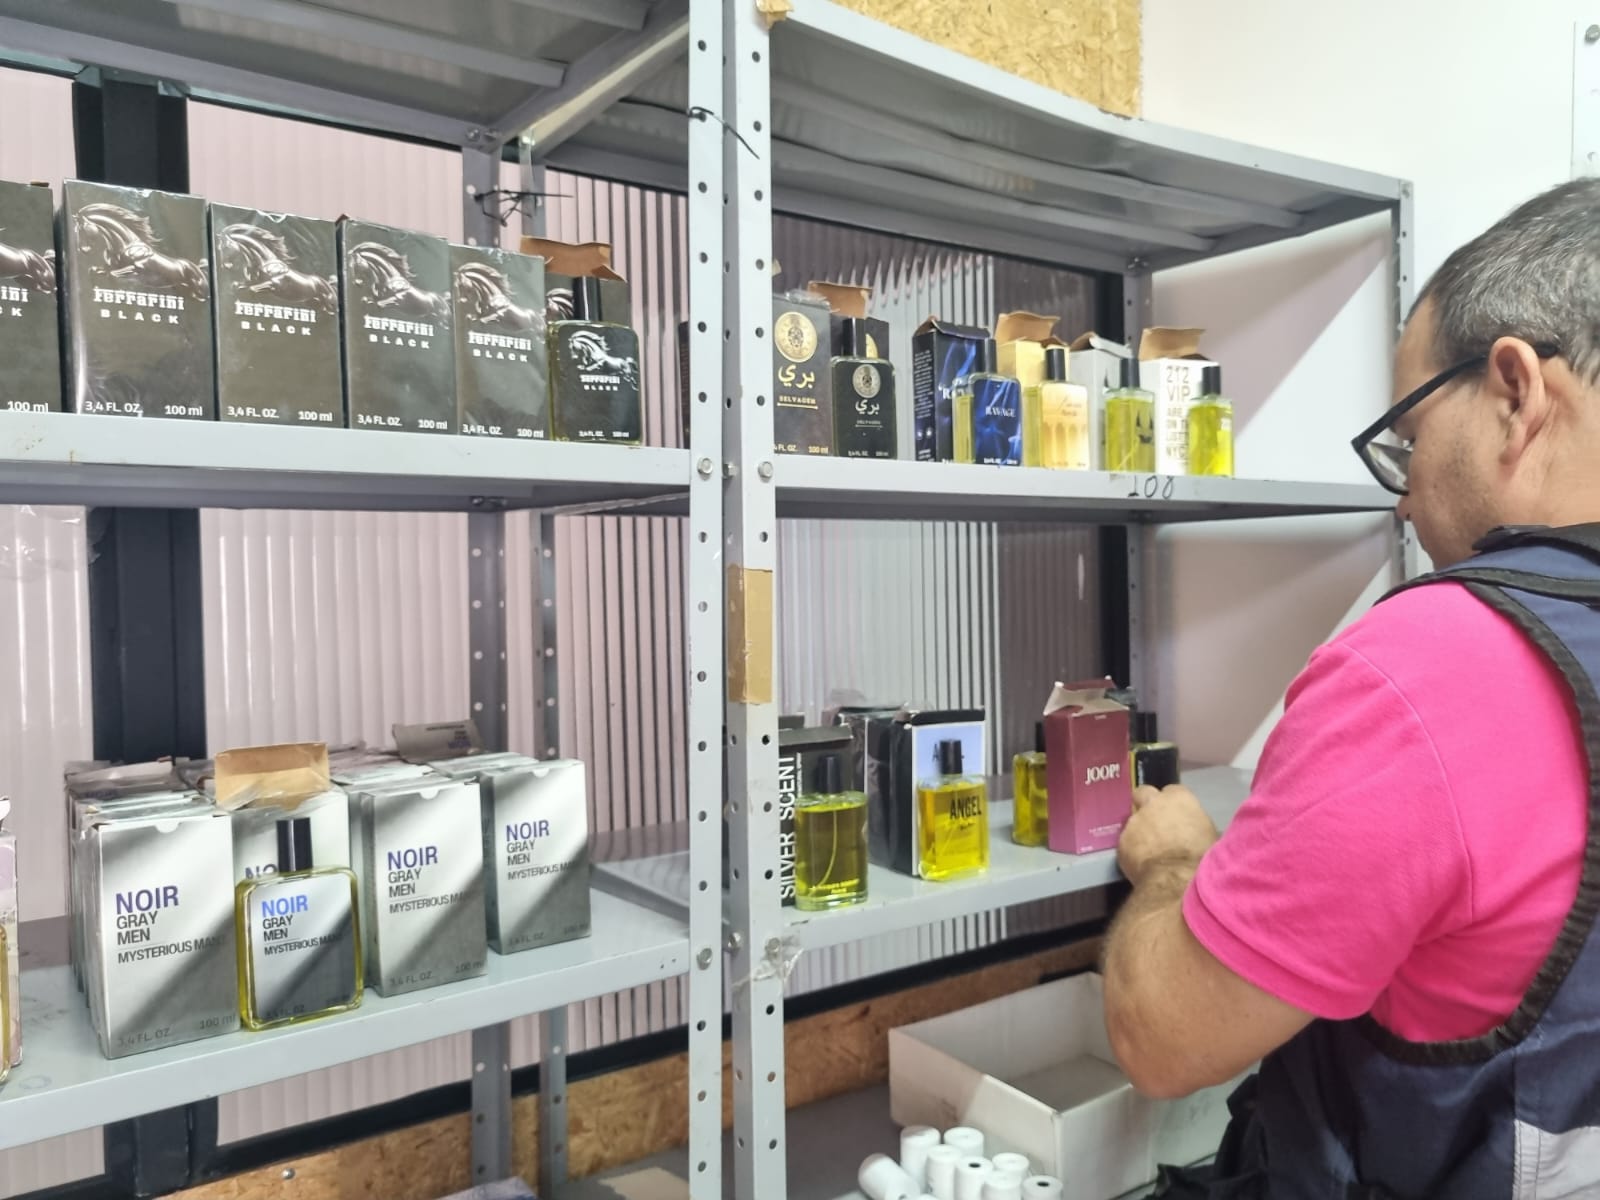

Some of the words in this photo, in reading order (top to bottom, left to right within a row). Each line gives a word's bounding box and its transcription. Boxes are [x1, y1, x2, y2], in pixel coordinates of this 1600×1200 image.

[100, 309, 179, 324] BLACK
[241, 321, 312, 336] BLACK
[369, 334, 430, 349] BLACK
[473, 348, 528, 362] BLACK
[8, 401, 31, 412] 100
[33, 402, 48, 413] ml
[85, 400, 104, 412] 3,4
[164, 404, 186, 416] 100
[188, 406, 203, 416] ml
[298, 411, 318, 421] 100
[319, 412, 333, 422] ml
[418, 419, 435, 429] 100
[436, 420, 448, 430] ml
[517, 428, 532, 438] 100
[1084, 763, 1120, 786] JOOP!
[778, 756, 796, 821] SCENT
[950, 796, 982, 820] ANGEL
[506, 820, 550, 842] NOIR
[506, 839, 536, 854] GRAY
[387, 846, 438, 871] NOIR
[508, 853, 530, 866] MEN
[779, 832, 796, 899] SILVER
[388, 868, 422, 884] GRAY
[508, 863, 560, 880] MYSTERIOUS
[389, 883, 416, 898] MEN
[116, 885, 179, 915] NOIR
[262, 894, 308, 918] NOIR
[390, 894, 448, 914] MYSTERIOUS
[116, 910, 158, 930] GRAY
[262, 914, 294, 930] GRAY
[118, 928, 150, 946] MEN
[264, 928, 288, 942] MEN
[118, 940, 193, 964] MYSTERIOUS
[264, 936, 318, 956] MYSTERIOUS
